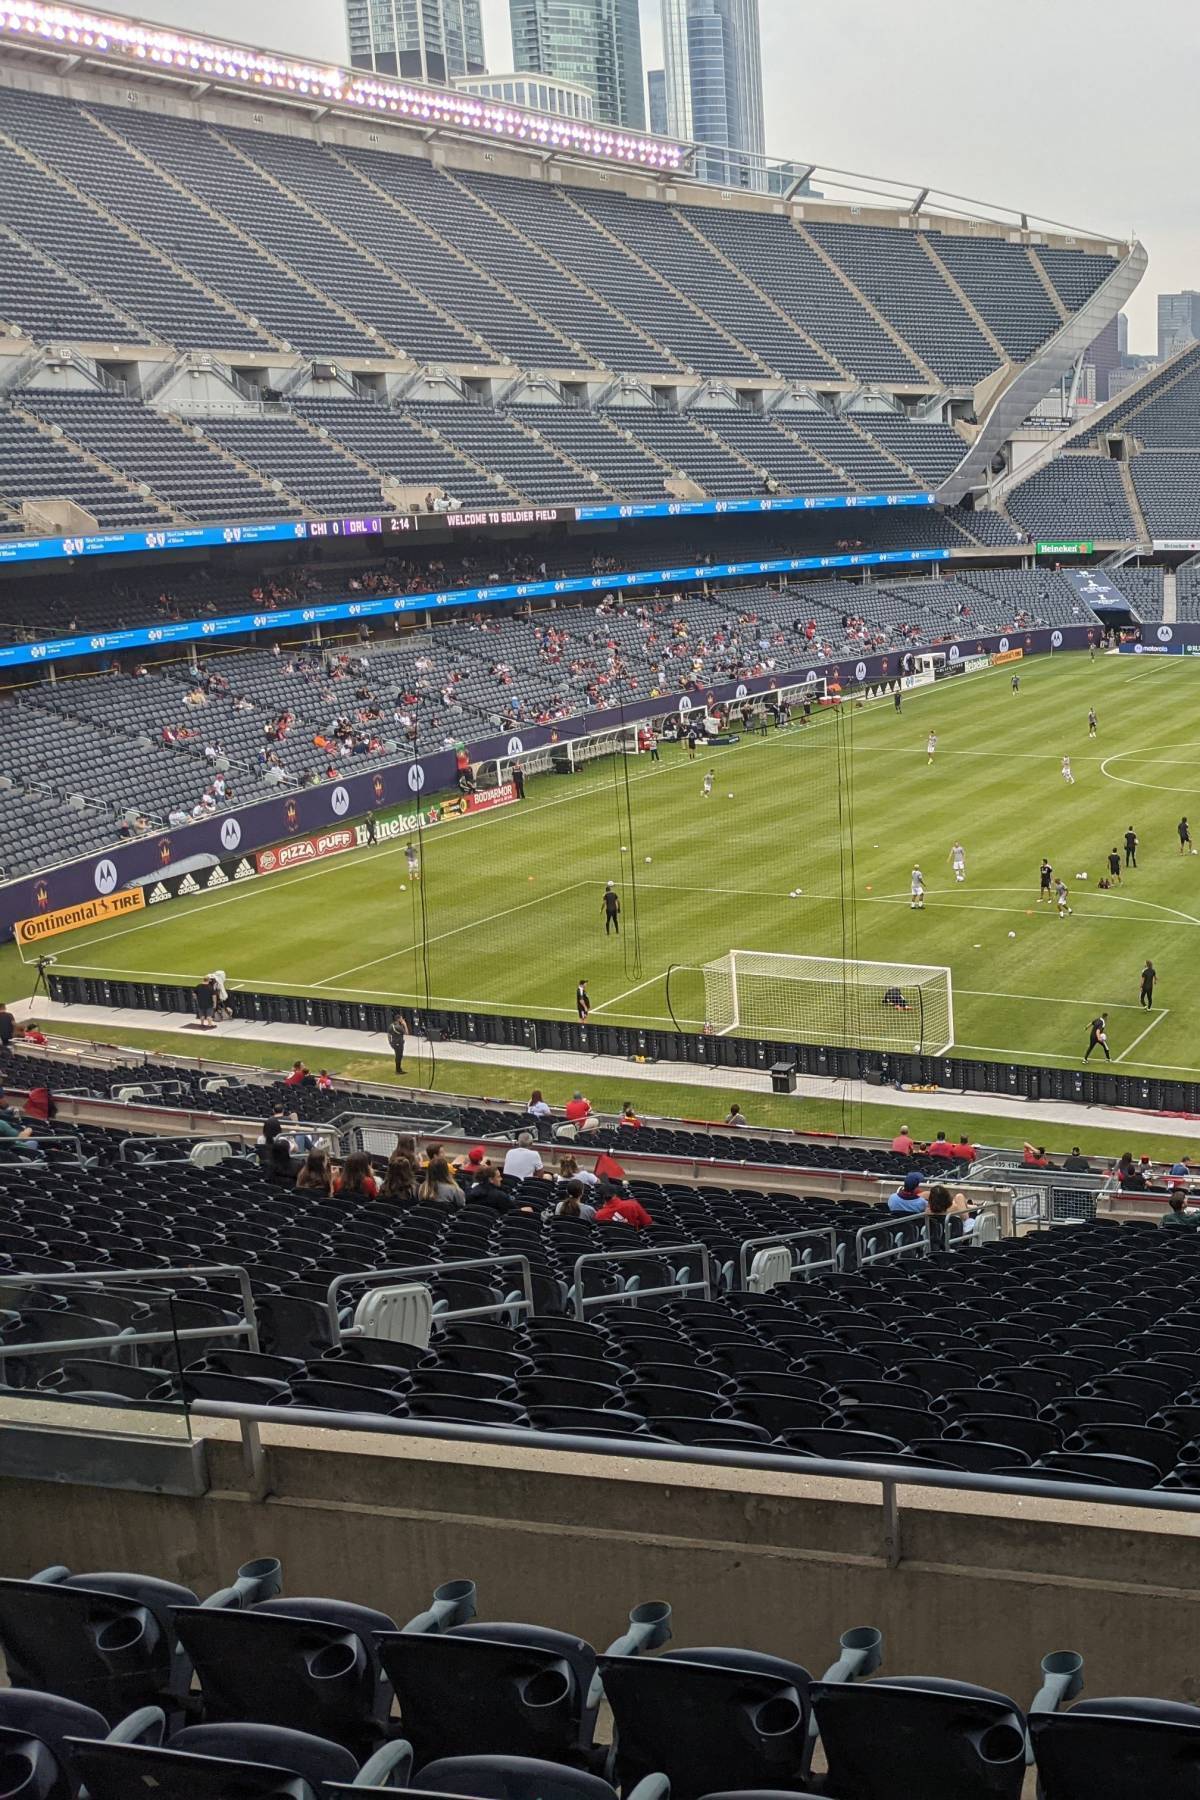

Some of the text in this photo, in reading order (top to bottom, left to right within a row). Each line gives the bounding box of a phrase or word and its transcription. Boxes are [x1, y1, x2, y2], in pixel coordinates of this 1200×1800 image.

[311, 509, 557, 535] CHI 0 ORL 0 2:14 WELCOME TO SOLDIER FIELD
[1041, 544, 1077, 553] Heineken
[1142, 645, 1168, 653] motorola
[474, 785, 513, 804] BODYARMOR
[355, 812, 426, 845] Hineken
[279, 832, 351, 864] PIZZA PUFF
[233, 868, 256, 879] adidas
[207, 875, 229, 887] adidas
[177, 883, 200, 896] adidas
[148, 892, 173, 905] adidas
[20, 893, 141, 941] Continental TIRE
